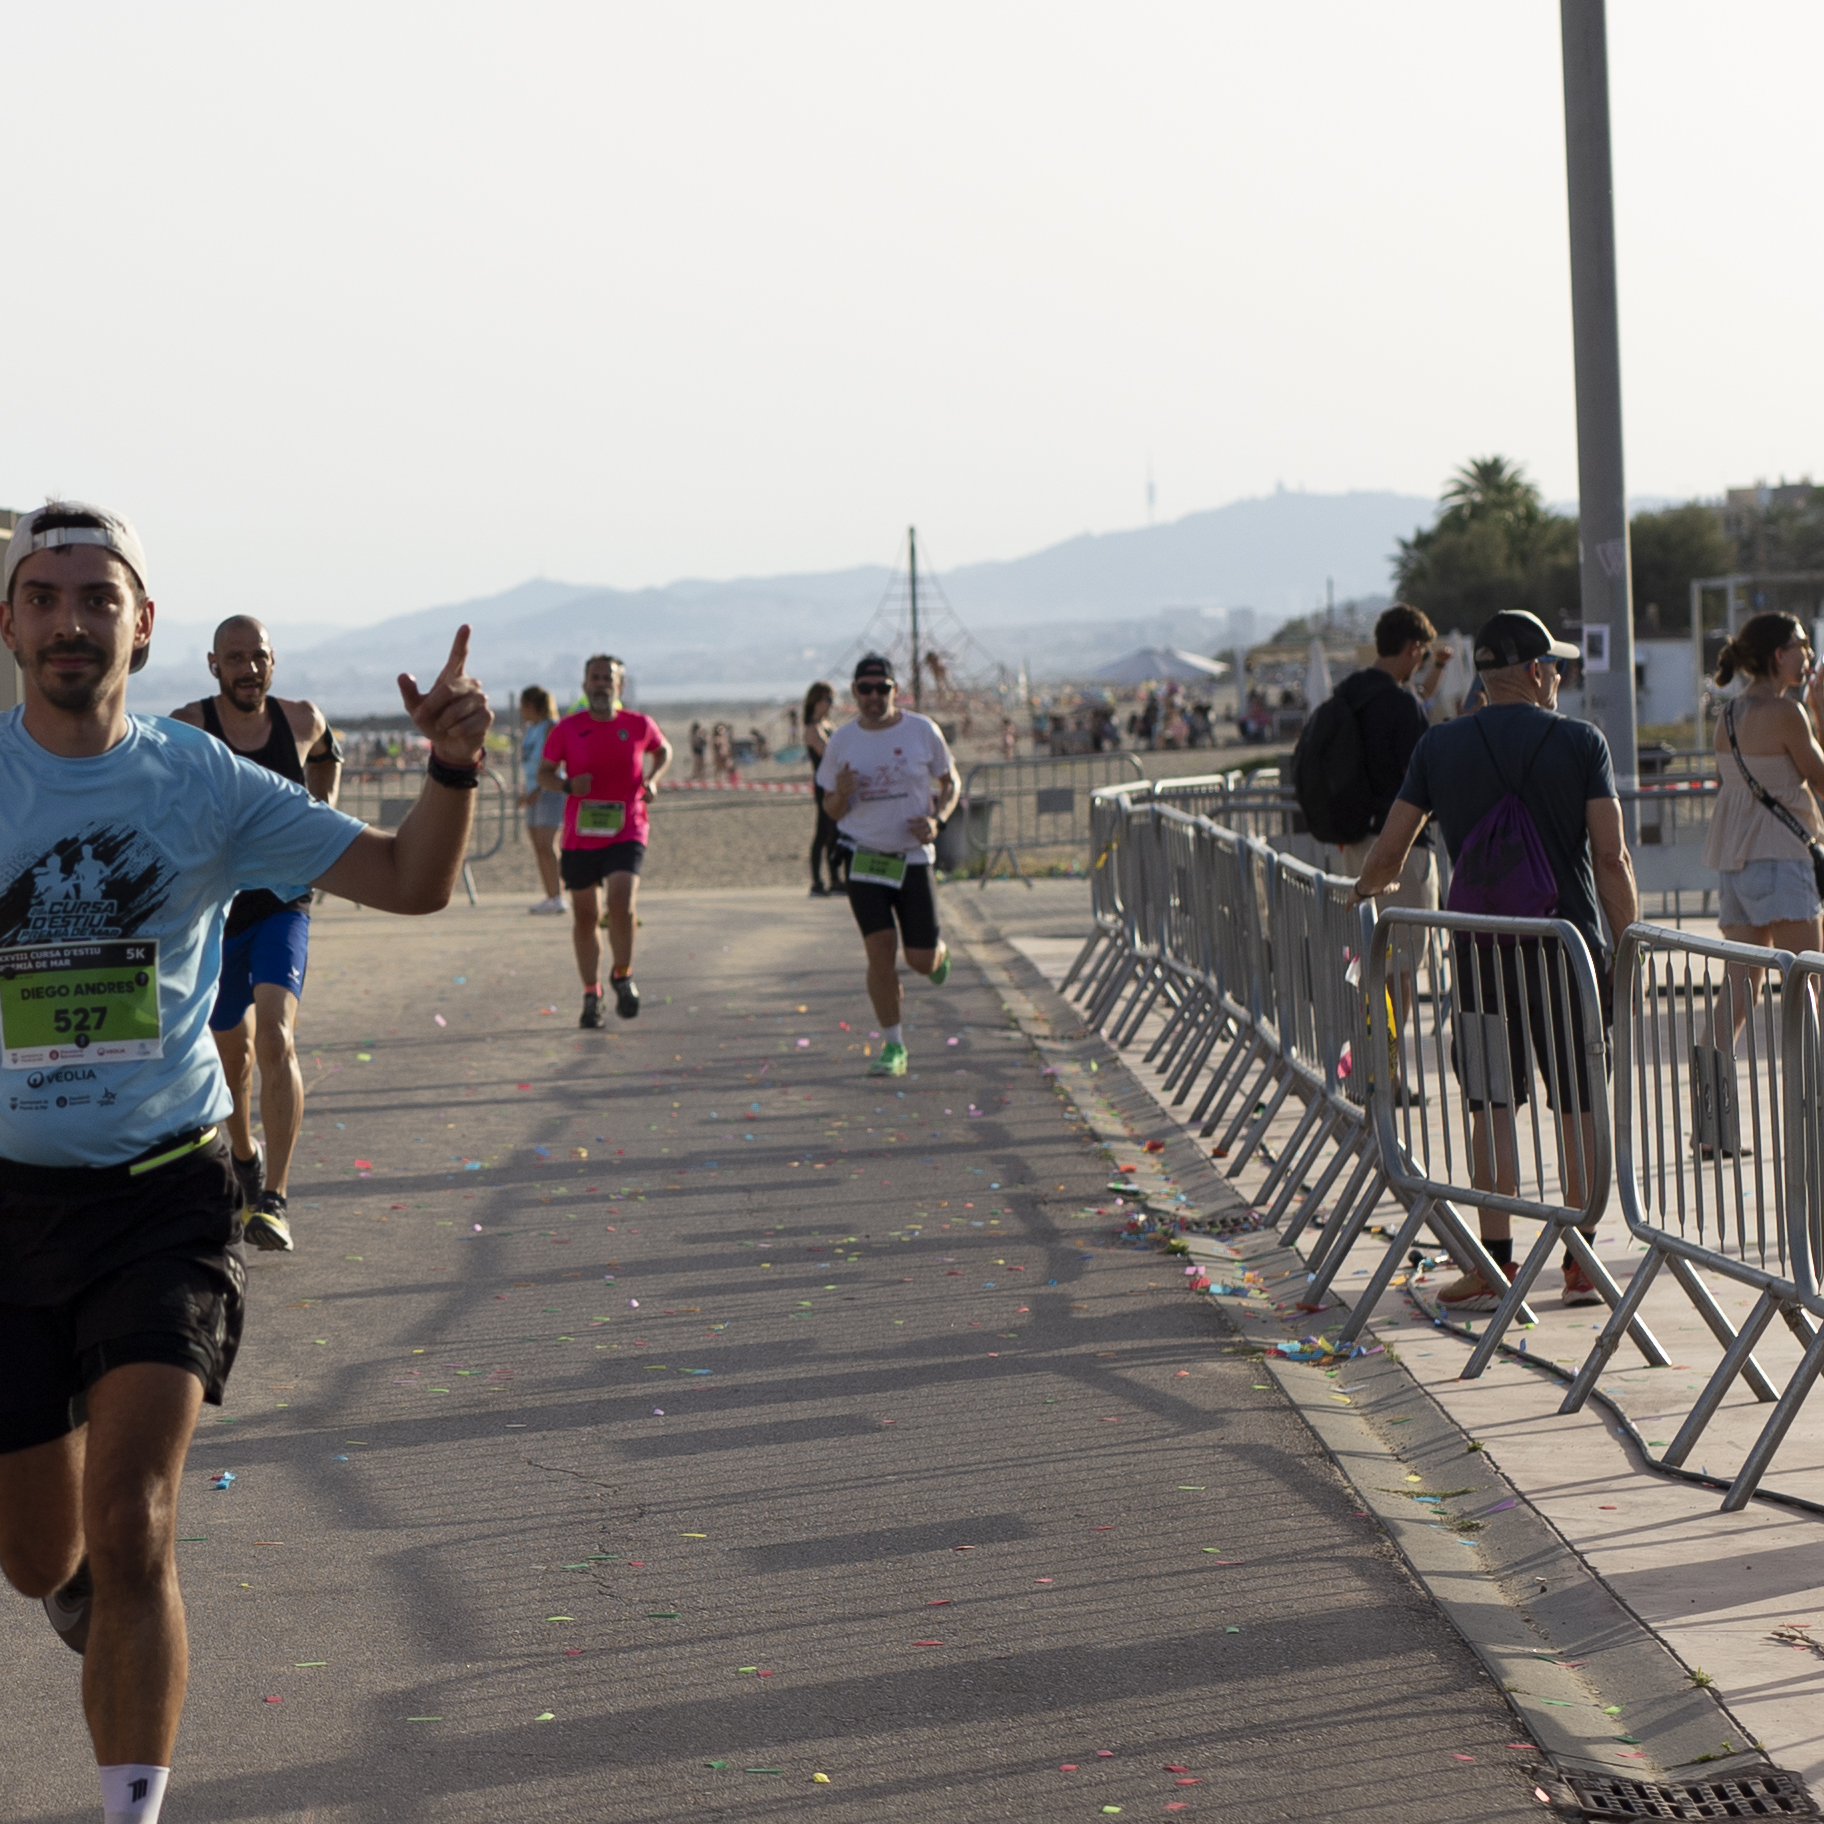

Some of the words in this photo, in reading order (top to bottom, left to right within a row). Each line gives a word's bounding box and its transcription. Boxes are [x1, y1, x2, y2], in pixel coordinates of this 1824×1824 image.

[48, 900, 115, 915] CURSA
[71, 927, 88, 937] DE
[30, 947, 61, 960] CURSA
[125, 947, 146, 960] 5K
[35, 961, 48, 969] DE
[50, 958, 71, 968] MAR
[20, 983, 70, 1000] DIEGO
[73, 980, 135, 997] ANDRES
[54, 1006, 108, 1033] 527
[46, 1069, 97, 1085] VEOLIA
